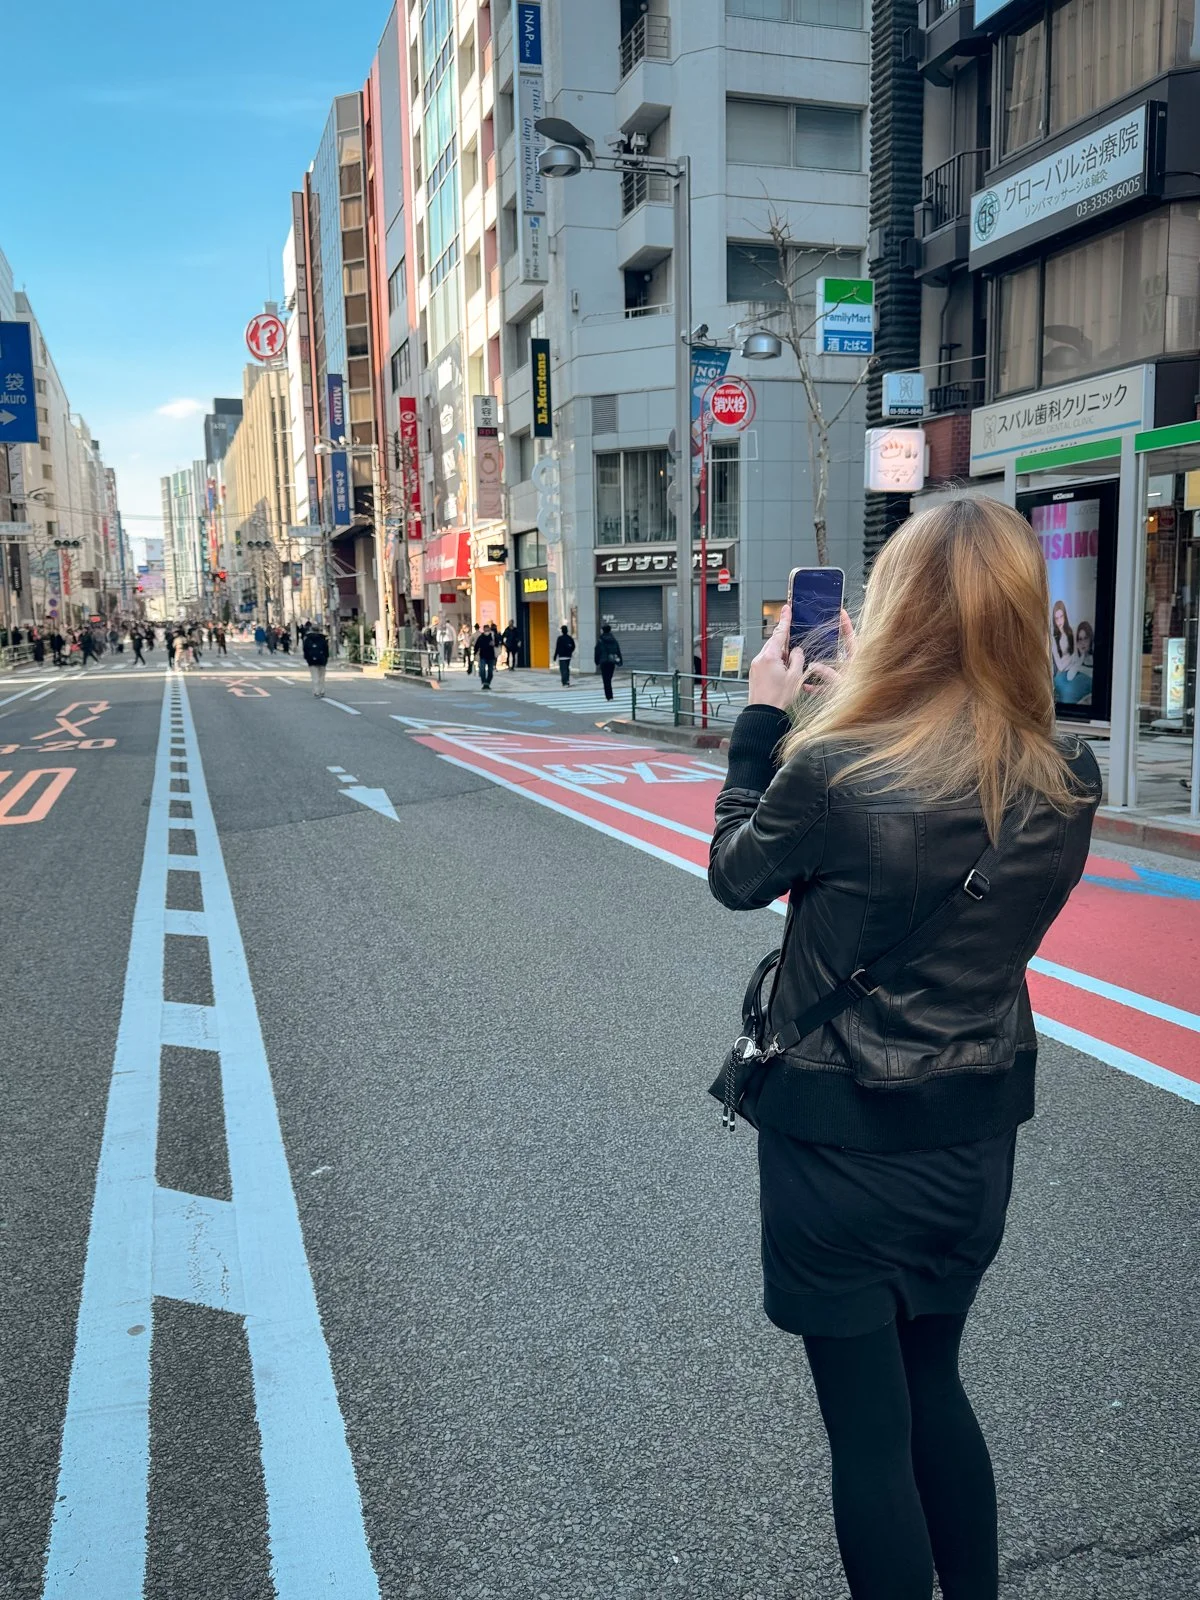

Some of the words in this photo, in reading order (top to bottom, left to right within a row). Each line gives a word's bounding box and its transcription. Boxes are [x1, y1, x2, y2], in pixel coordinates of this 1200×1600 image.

[524, 10, 535, 40] INAP
[1004, 121, 1139, 211] グローバル治療院
[1076, 176, 1141, 217] 03-3358-6005
[825, 312, 871, 324] FamilyMart
[827, 338, 840, 351] 酒
[843, 339, 868, 351] たばこ
[333, 386, 342, 425] MIZUHO
[714, 395, 746, 413] 消火栓
[997, 383, 1127, 434] スバル歯科クリニック
